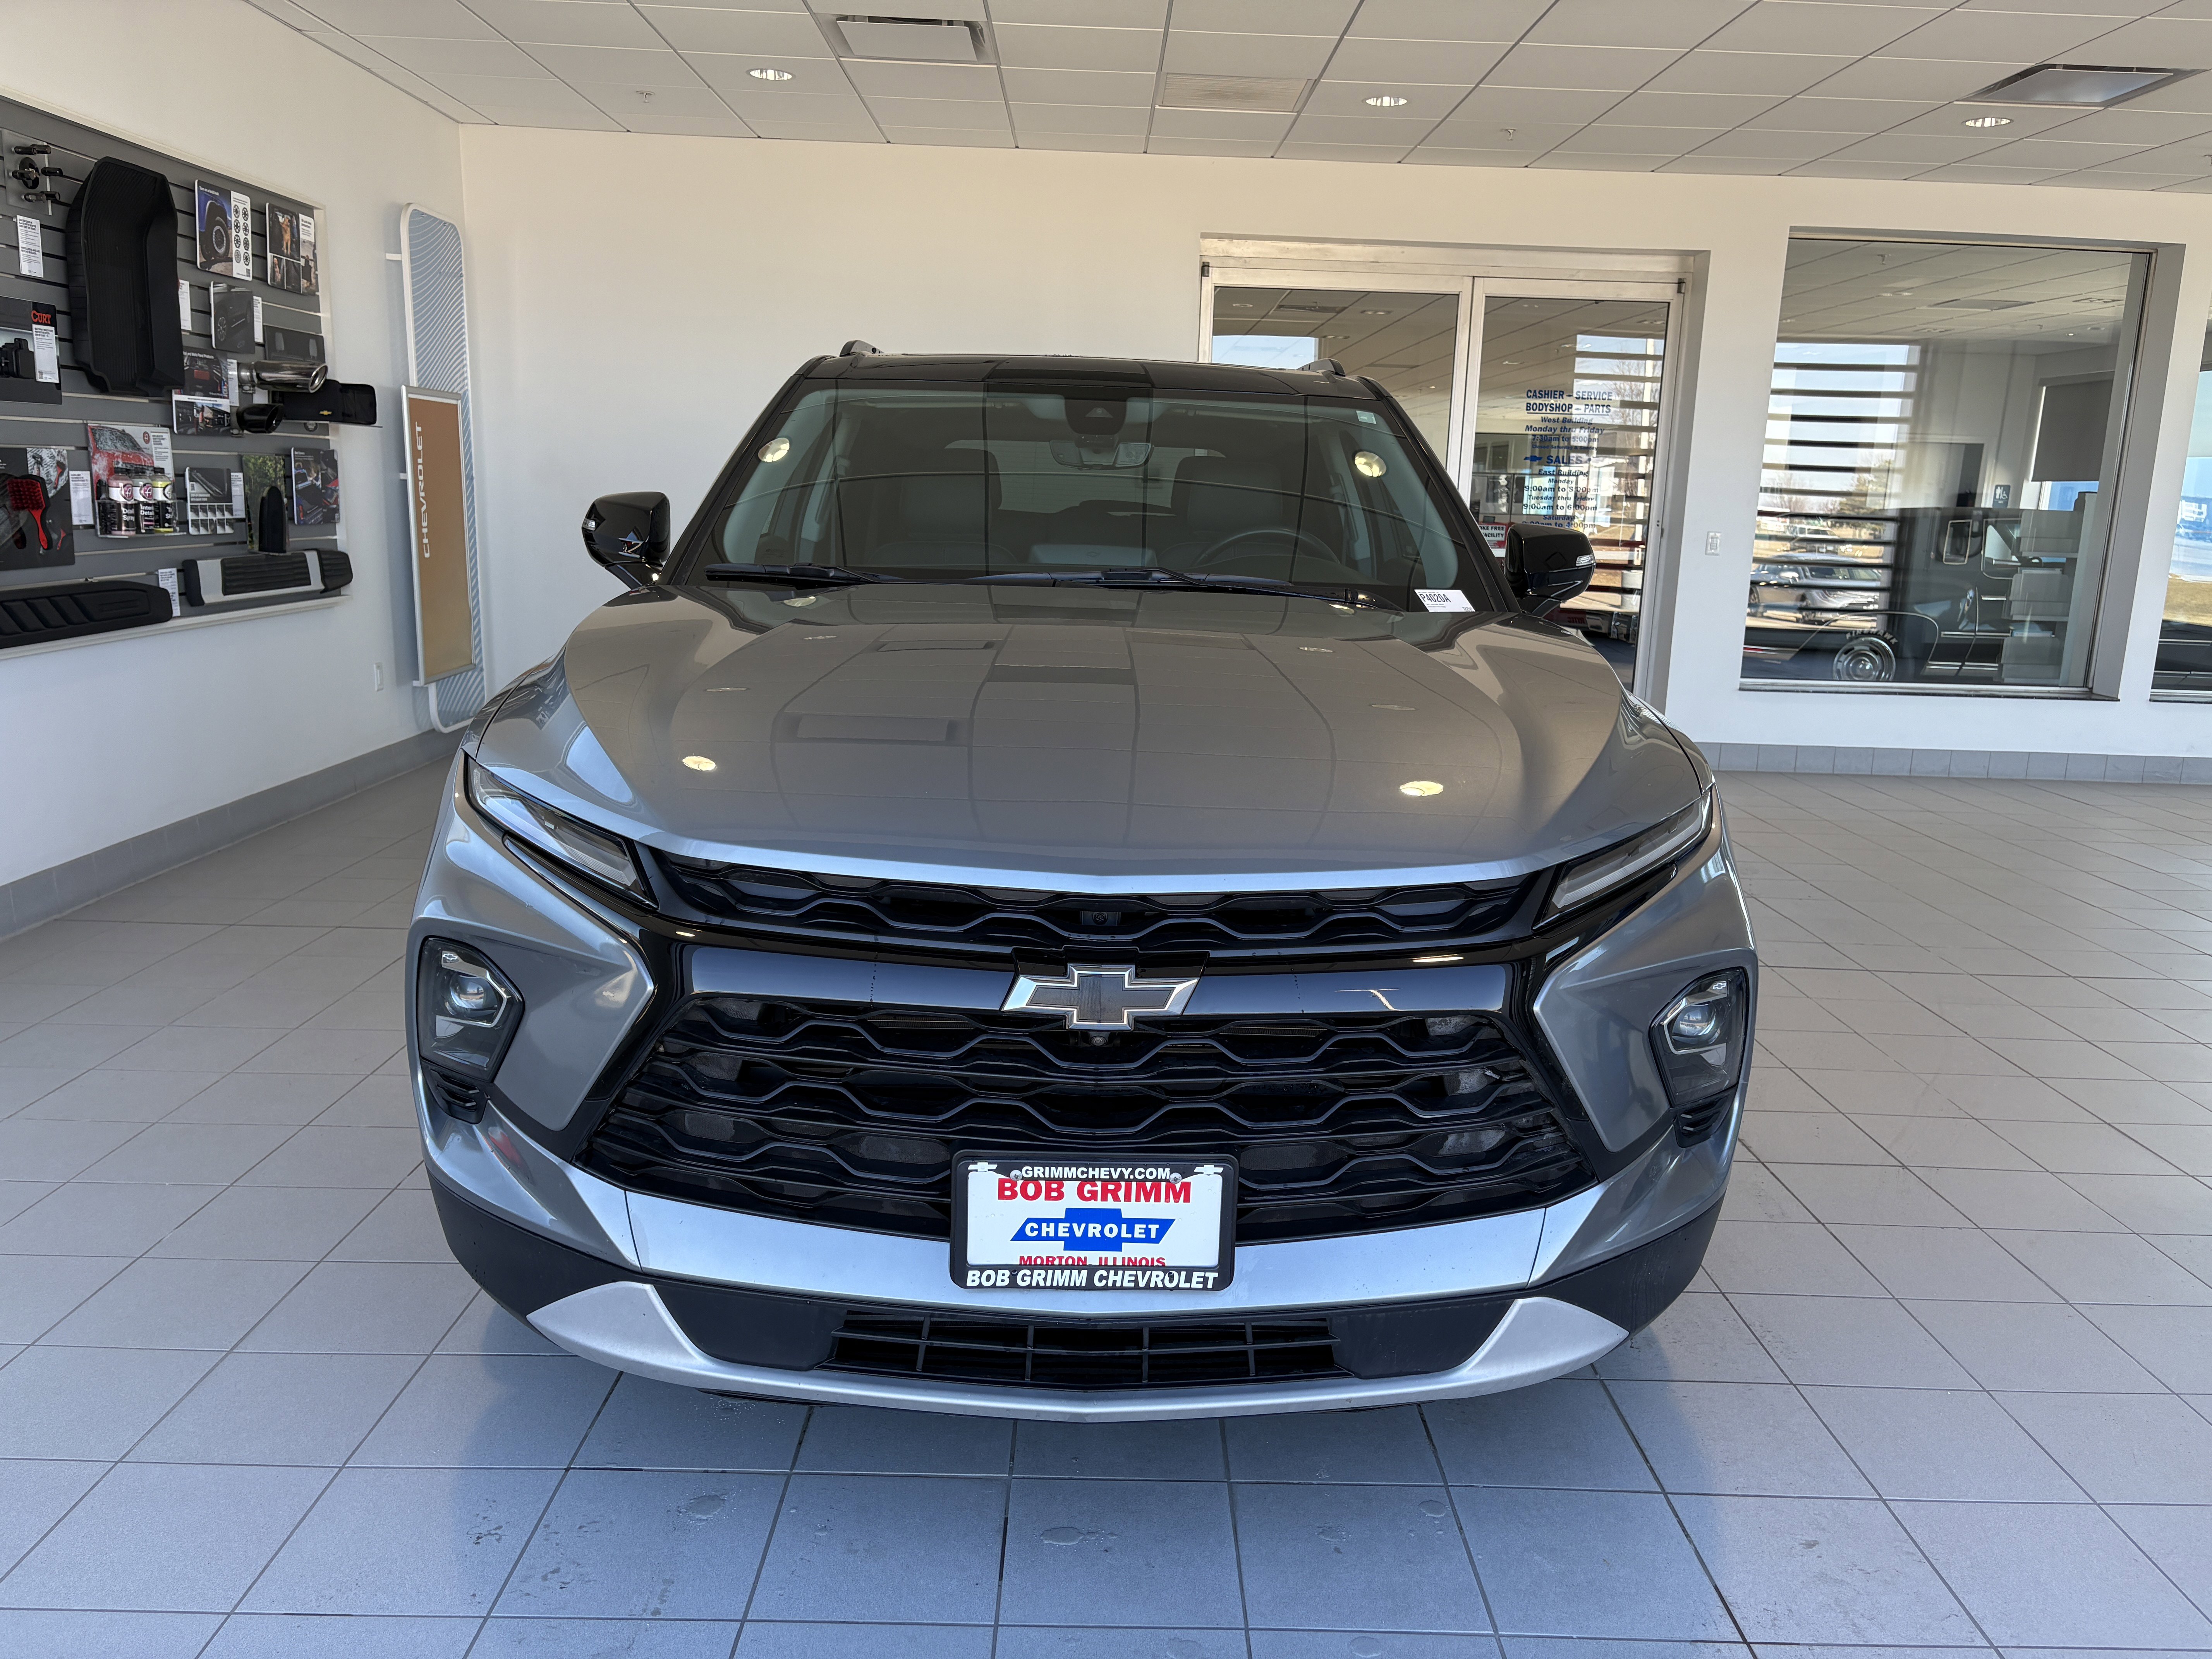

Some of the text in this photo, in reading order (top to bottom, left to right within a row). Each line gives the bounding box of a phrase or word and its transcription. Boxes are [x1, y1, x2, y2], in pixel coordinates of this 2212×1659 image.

[1526, 389, 1613, 401] CASHIER SERVICE
[1526, 402, 1611, 414] BODYSHOP PARTS
[1561, 417, 1593, 425] Building
[1525, 425, 1558, 434] Monday
[1546, 455, 1583, 464] SALES
[416, 421, 430, 558] CHEVROLET
[1419, 594, 1451, 603] P4020A
[1846, 628, 1898, 645] FIREHAWK
[1021, 1166, 1170, 1180] GRIMMCHEVY.COM
[998, 1178, 1191, 1203] BOB GRIMM
[1025, 1222, 1159, 1239] CHEVROLET
[1099, 1257, 1166, 1266] ILLINOIS
[966, 1269, 1218, 1289] BOB GRIMM CHEVROLET
